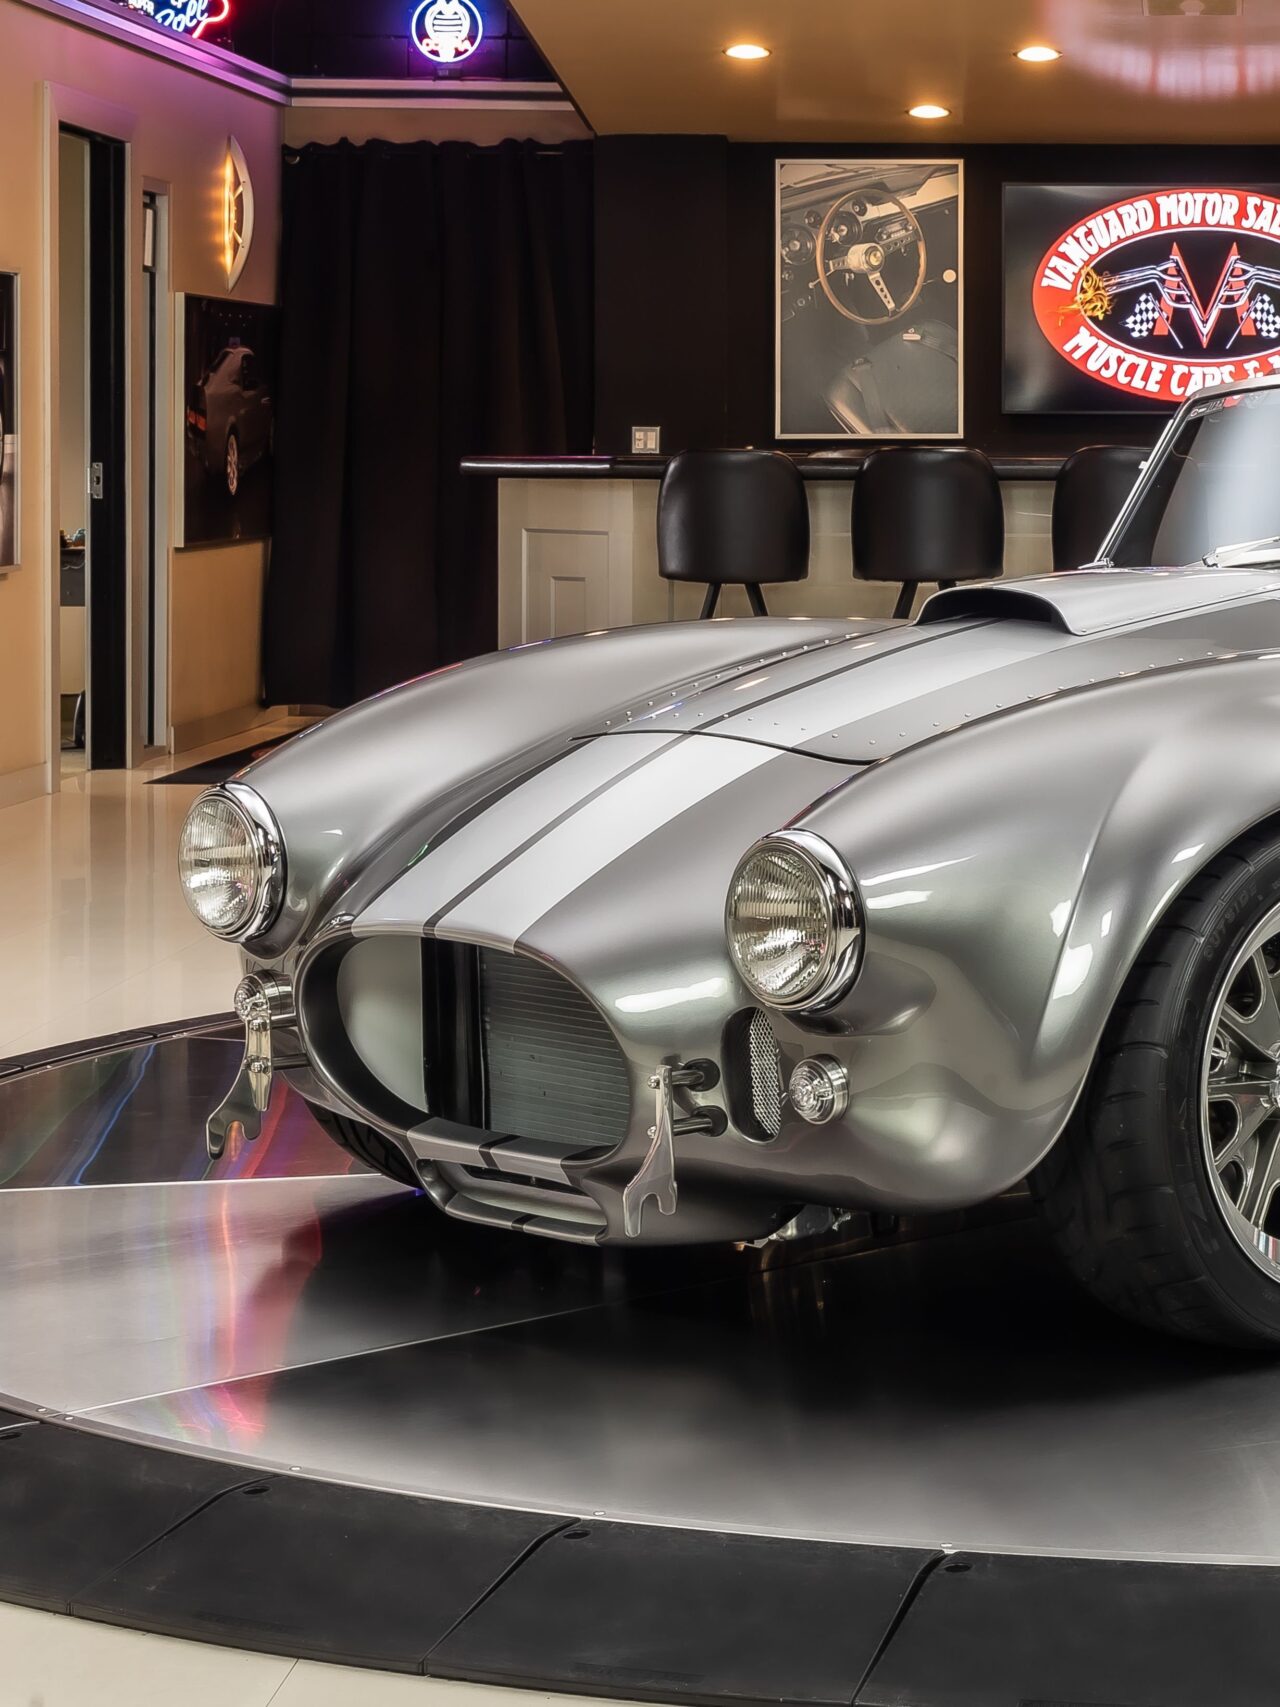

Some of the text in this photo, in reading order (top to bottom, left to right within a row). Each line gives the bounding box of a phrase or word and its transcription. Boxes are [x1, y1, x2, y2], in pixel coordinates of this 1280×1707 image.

[1041, 199, 1155, 291] VANGUARD
[1155, 191, 1241, 227] MOTOR
[1062, 325, 1168, 393] MUSCLE
